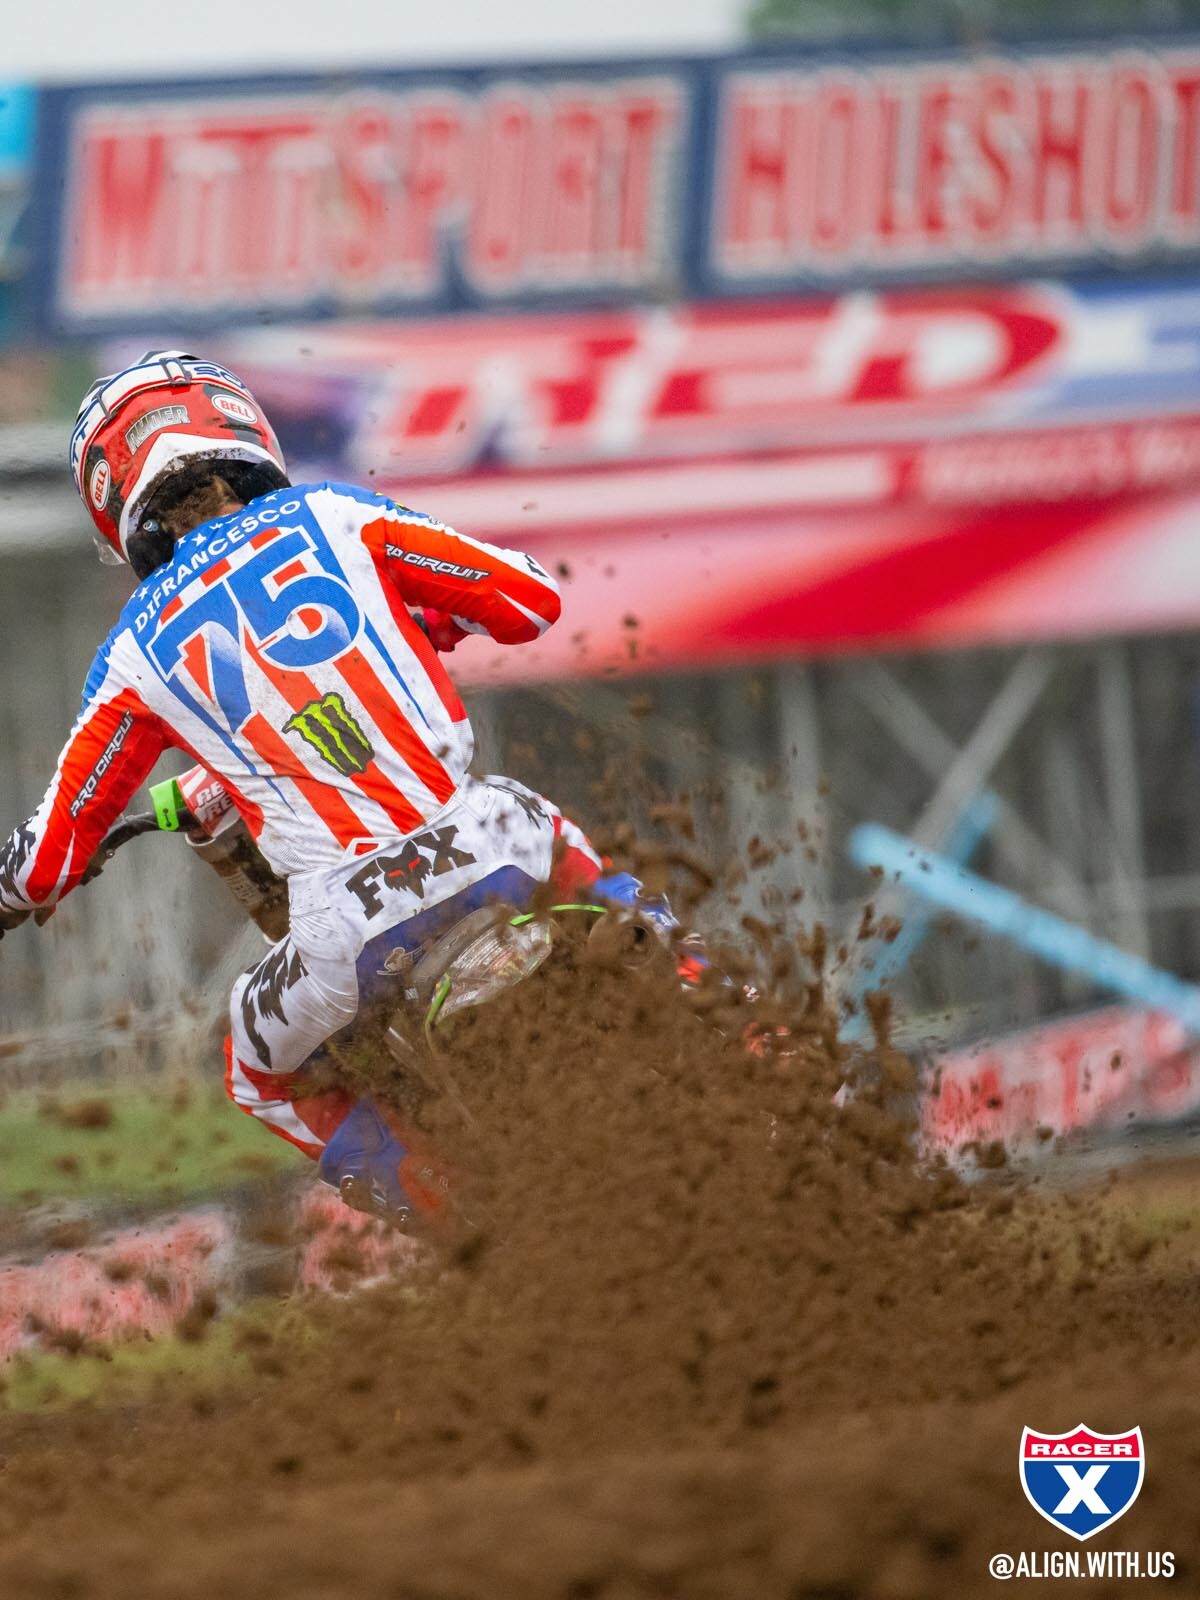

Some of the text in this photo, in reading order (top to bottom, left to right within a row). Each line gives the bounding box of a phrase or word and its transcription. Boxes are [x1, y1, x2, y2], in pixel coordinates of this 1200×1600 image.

[220, 400, 251, 418] BELL
[95, 469, 107, 503] BELL
[134, 500, 301, 633] DIFRANCESCO
[403, 551, 489, 581] CIRCUIT
[146, 525, 365, 735] 75
[70, 775, 97, 817] PRO
[344, 824, 478, 922] FOX
